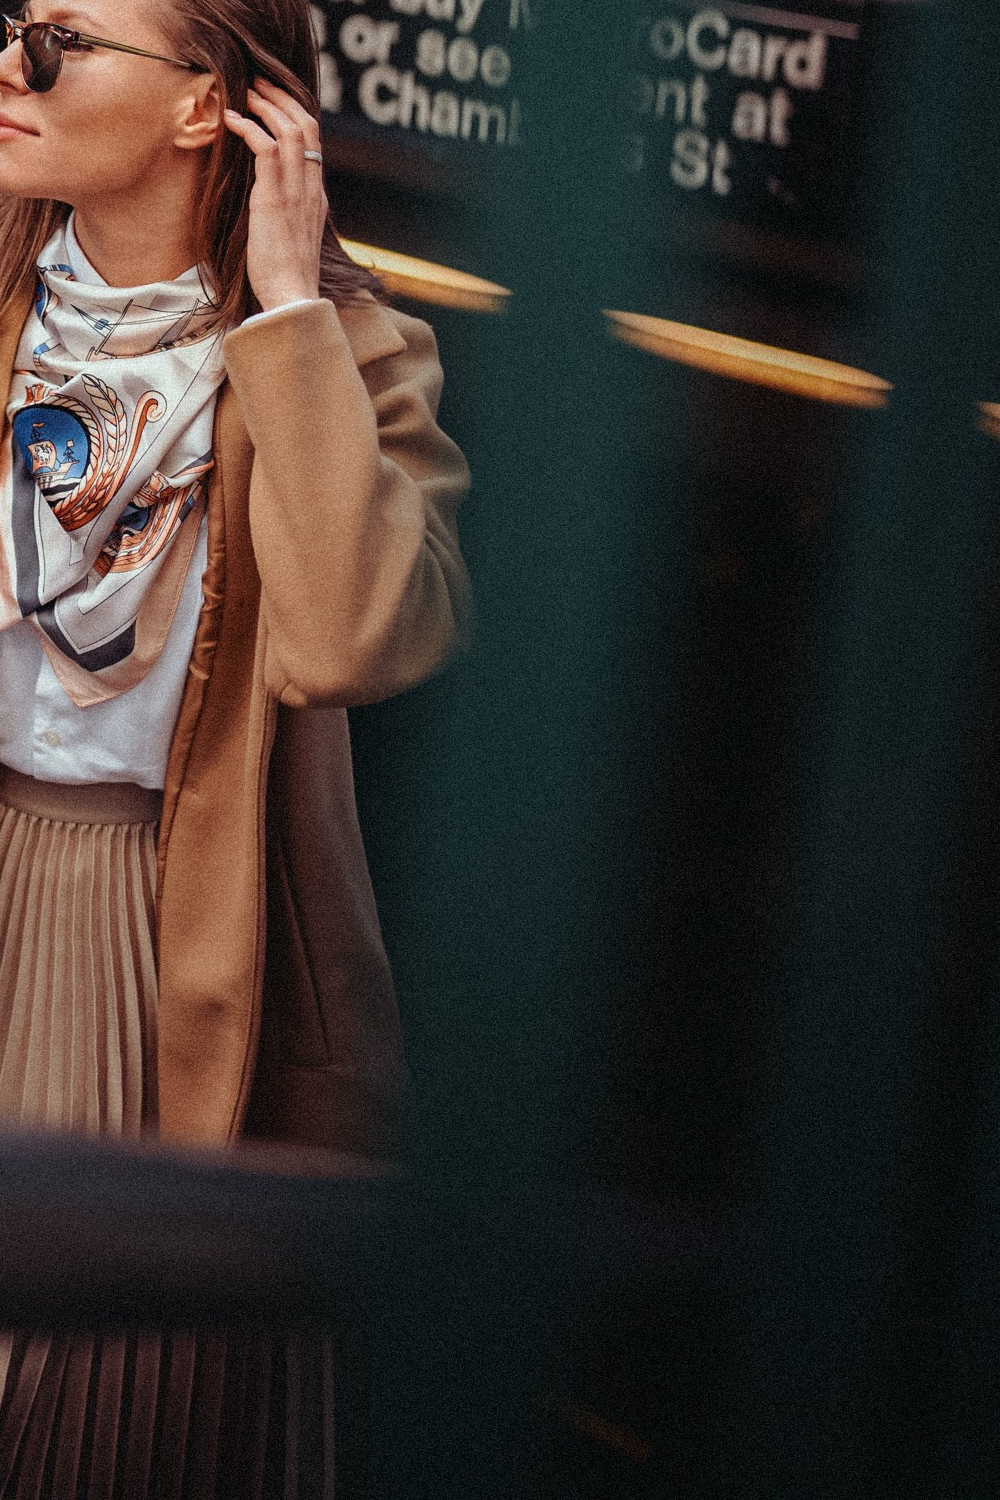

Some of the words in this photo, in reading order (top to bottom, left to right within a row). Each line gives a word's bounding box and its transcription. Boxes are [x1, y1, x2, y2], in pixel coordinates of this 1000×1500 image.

[338, 13, 399, 64] or
[415, 28, 511, 88] see
[731, 88, 793, 148] at
[670, 129, 732, 198] St
